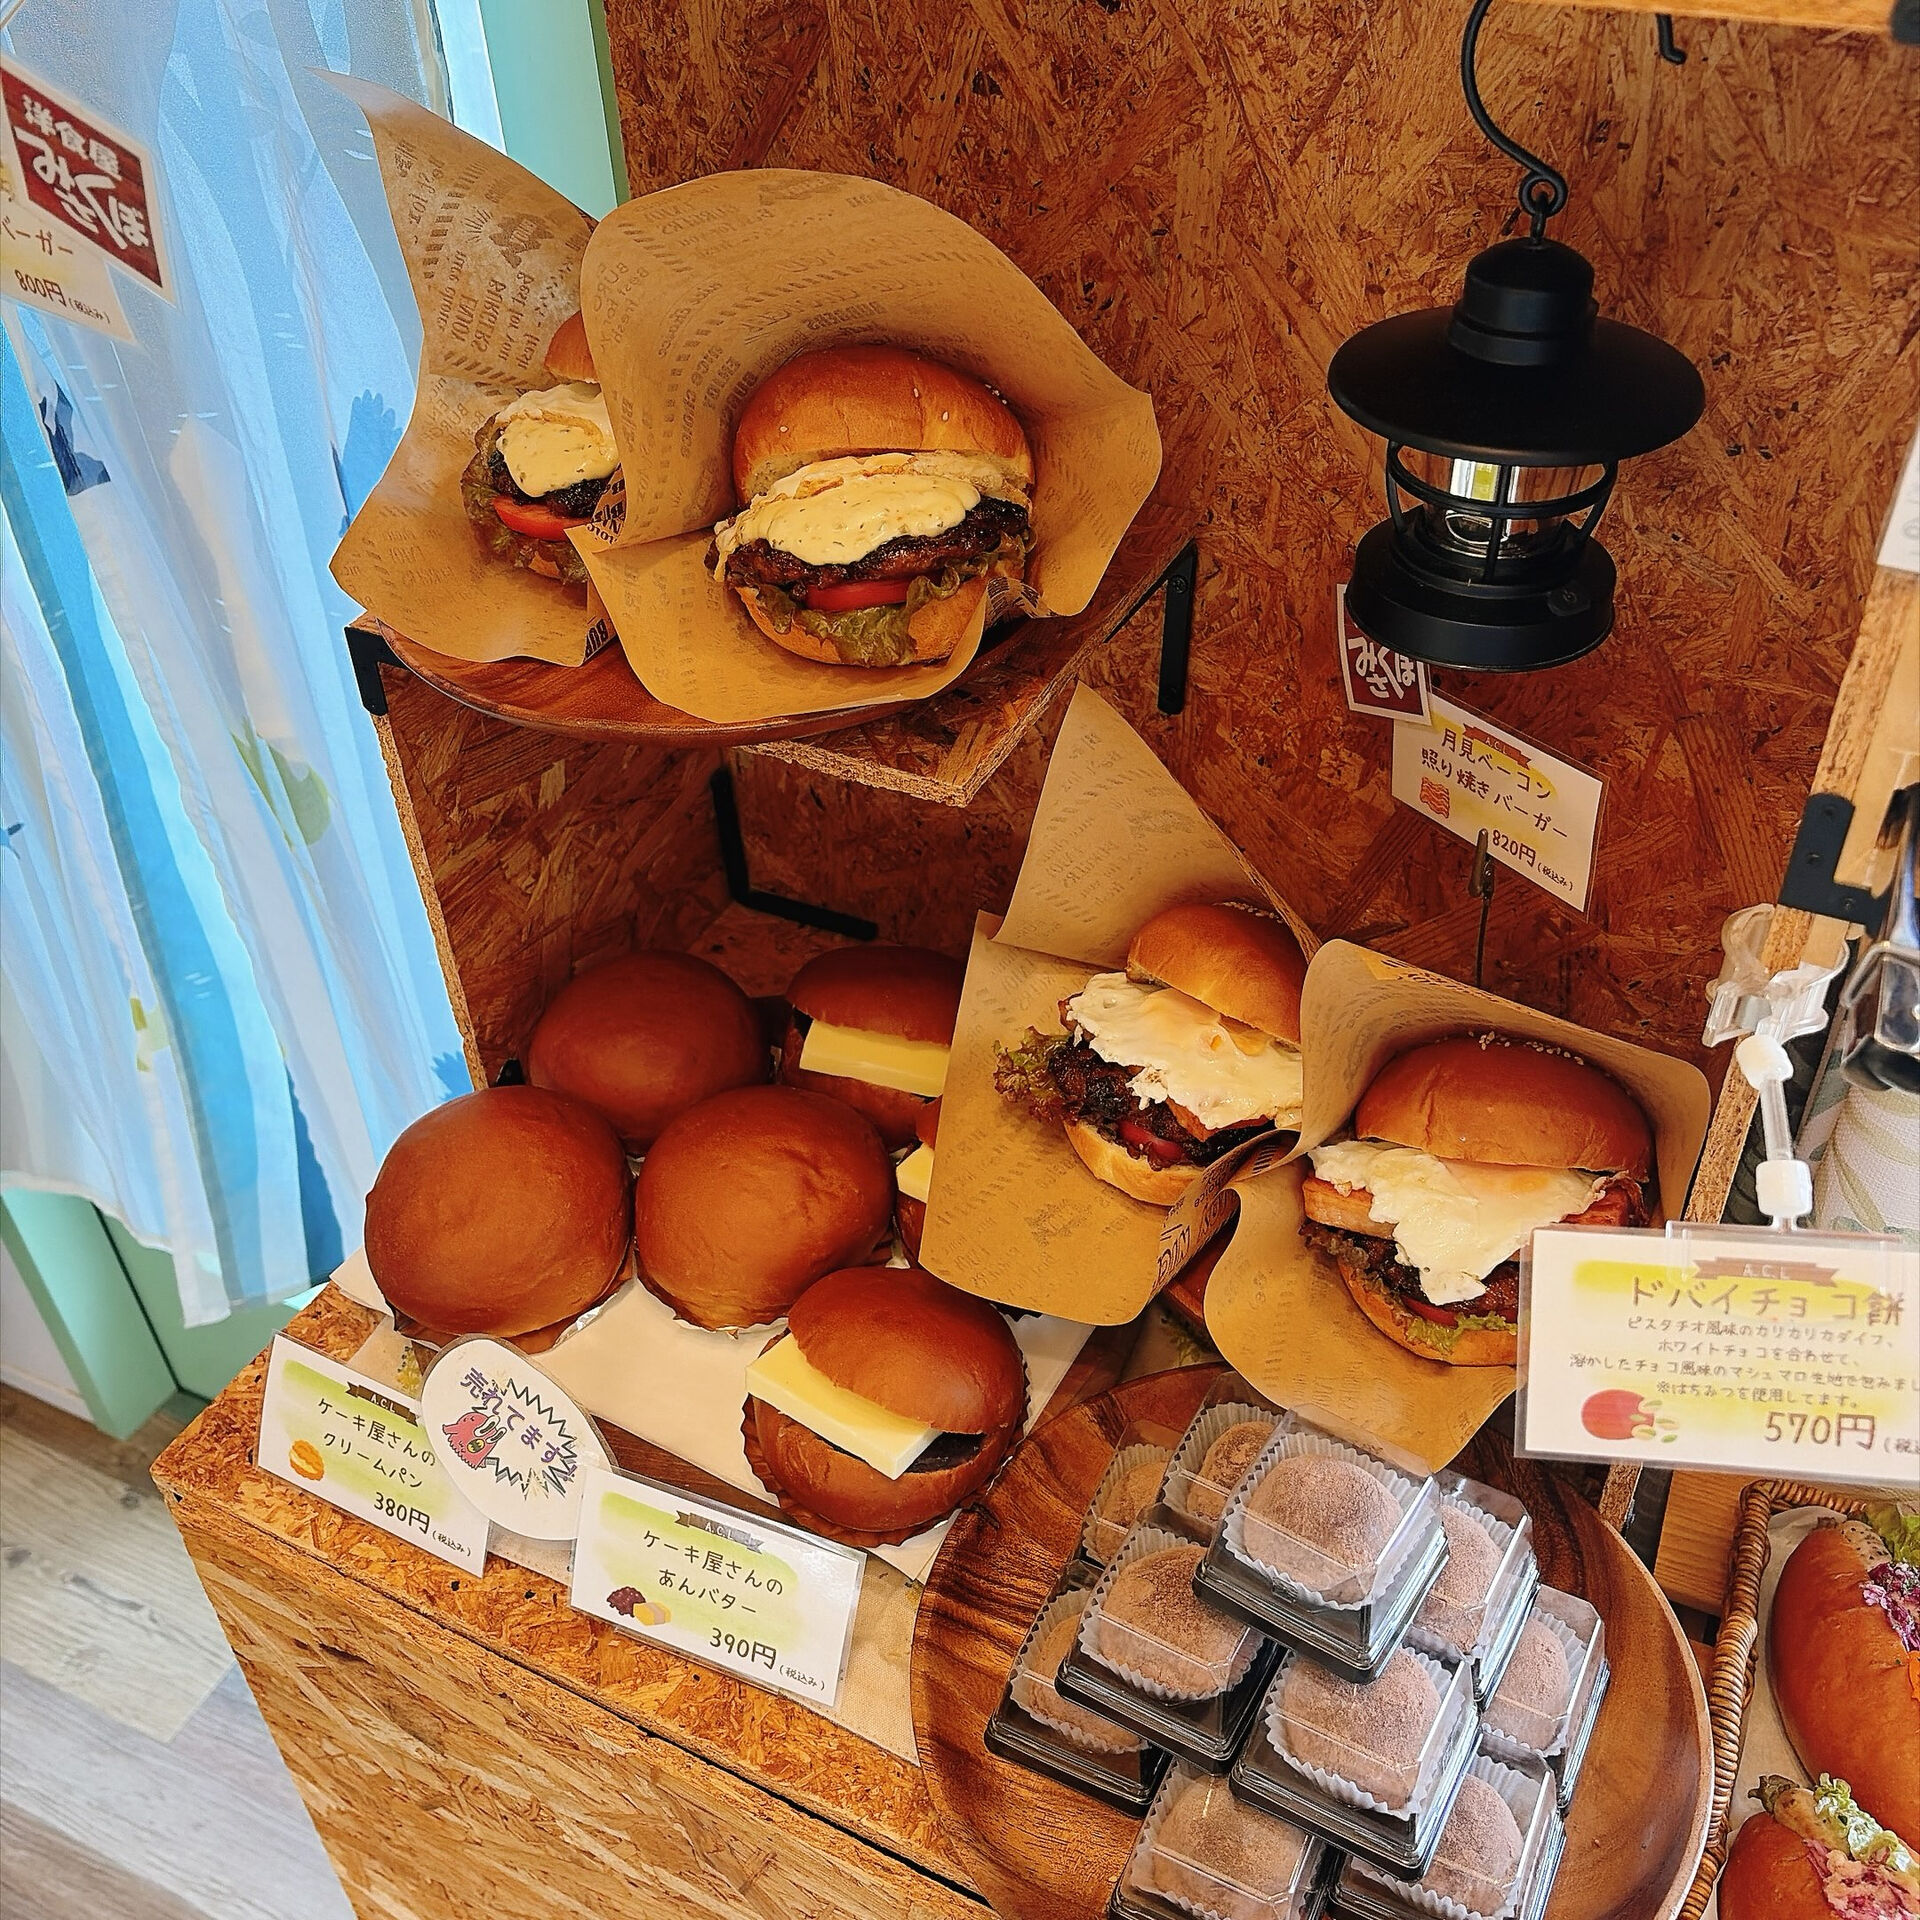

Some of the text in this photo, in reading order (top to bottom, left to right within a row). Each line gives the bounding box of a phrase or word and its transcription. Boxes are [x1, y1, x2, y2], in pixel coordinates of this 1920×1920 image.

[22, 94, 121, 180] 洋食屋
[14, 269, 67, 307] 800円
[1421, 747, 1568, 839] 照り焼きバーガー
[1442, 728, 1551, 799] 月見ベーコン
[1492, 829, 1573, 891] 820円 (税込み)
[1631, 1276, 1903, 1326] ドバイチョコ餅
[317, 1398, 437, 1467] ケーキ屋さんの
[370, 1394, 396, 1413] A.C.L
[1764, 1410, 1876, 1450] 570円
[323, 1432, 423, 1489] クリームパン
[373, 1492, 471, 1557] 380円 (税込み)
[705, 1521, 734, 1540] A.C.L
[643, 1530, 783, 1597] ケーキ屋さんの
[658, 1568, 757, 1614] あんバター
[709, 1627, 825, 1691] 390円 (税込み)
